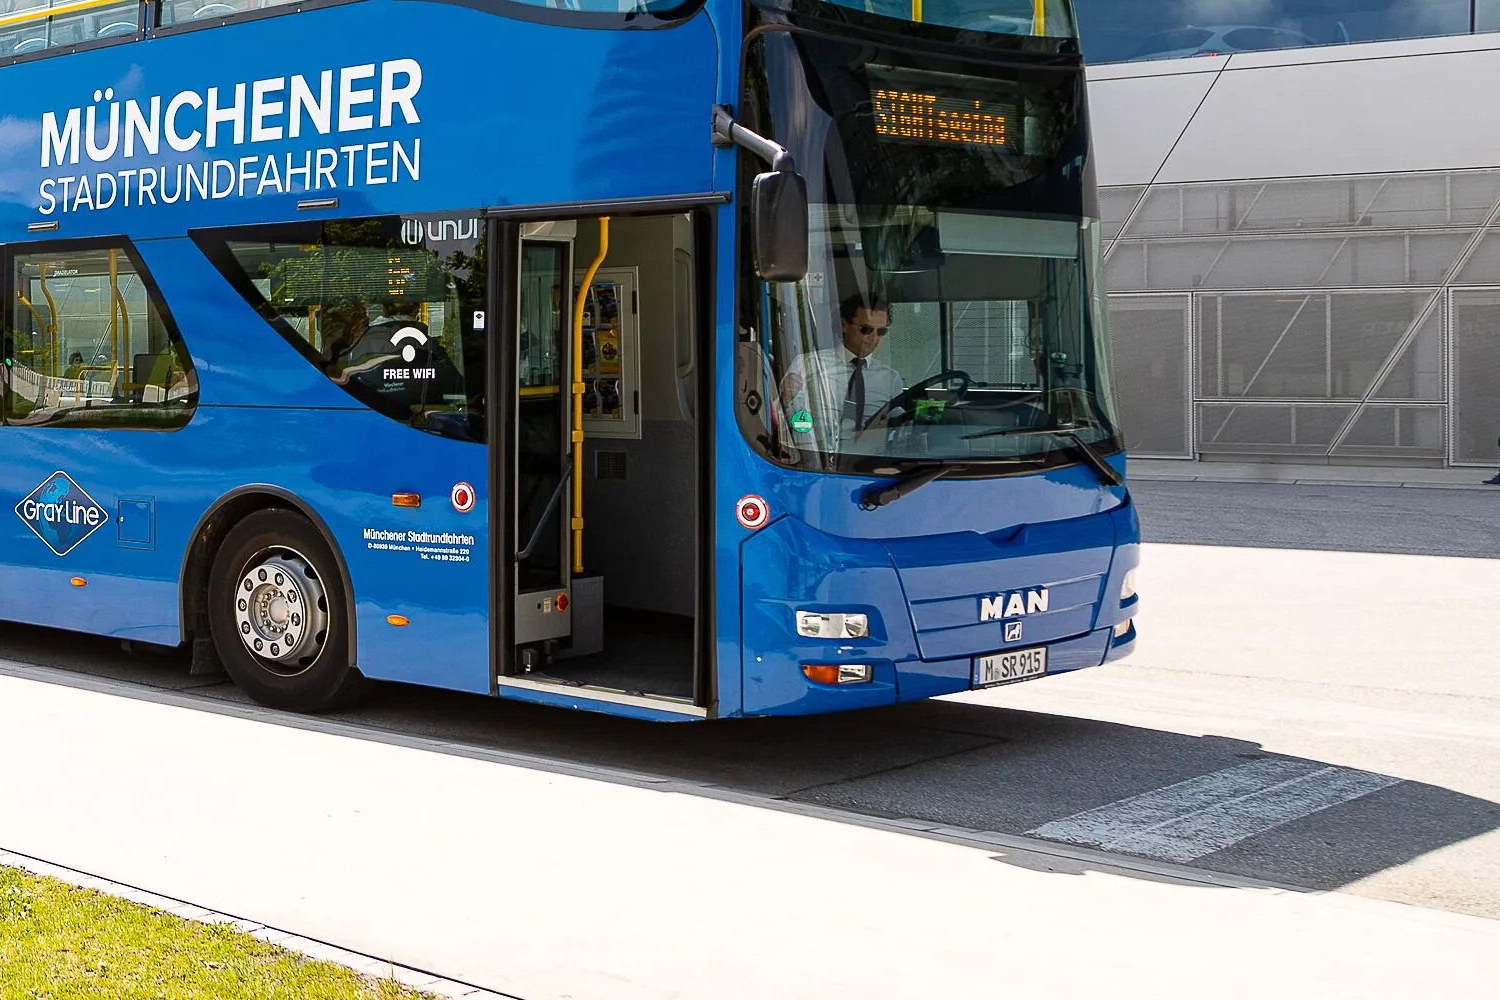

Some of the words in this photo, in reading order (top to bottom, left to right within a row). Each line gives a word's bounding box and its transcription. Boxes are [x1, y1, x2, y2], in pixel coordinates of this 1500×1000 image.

[40, 58, 423, 168] MÜNCHENER
[37, 138, 421, 215] STADTRUNDFAHRTEN
[383, 368, 410, 380] FREE
[412, 368, 436, 379] WIFI
[798, 412, 806, 422] 4
[363, 529, 406, 541] Münchener
[407, 531, 474, 545] Stadtrundfahrten
[980, 590, 1049, 621] MAN
[1020, 652, 1041, 674] 915
